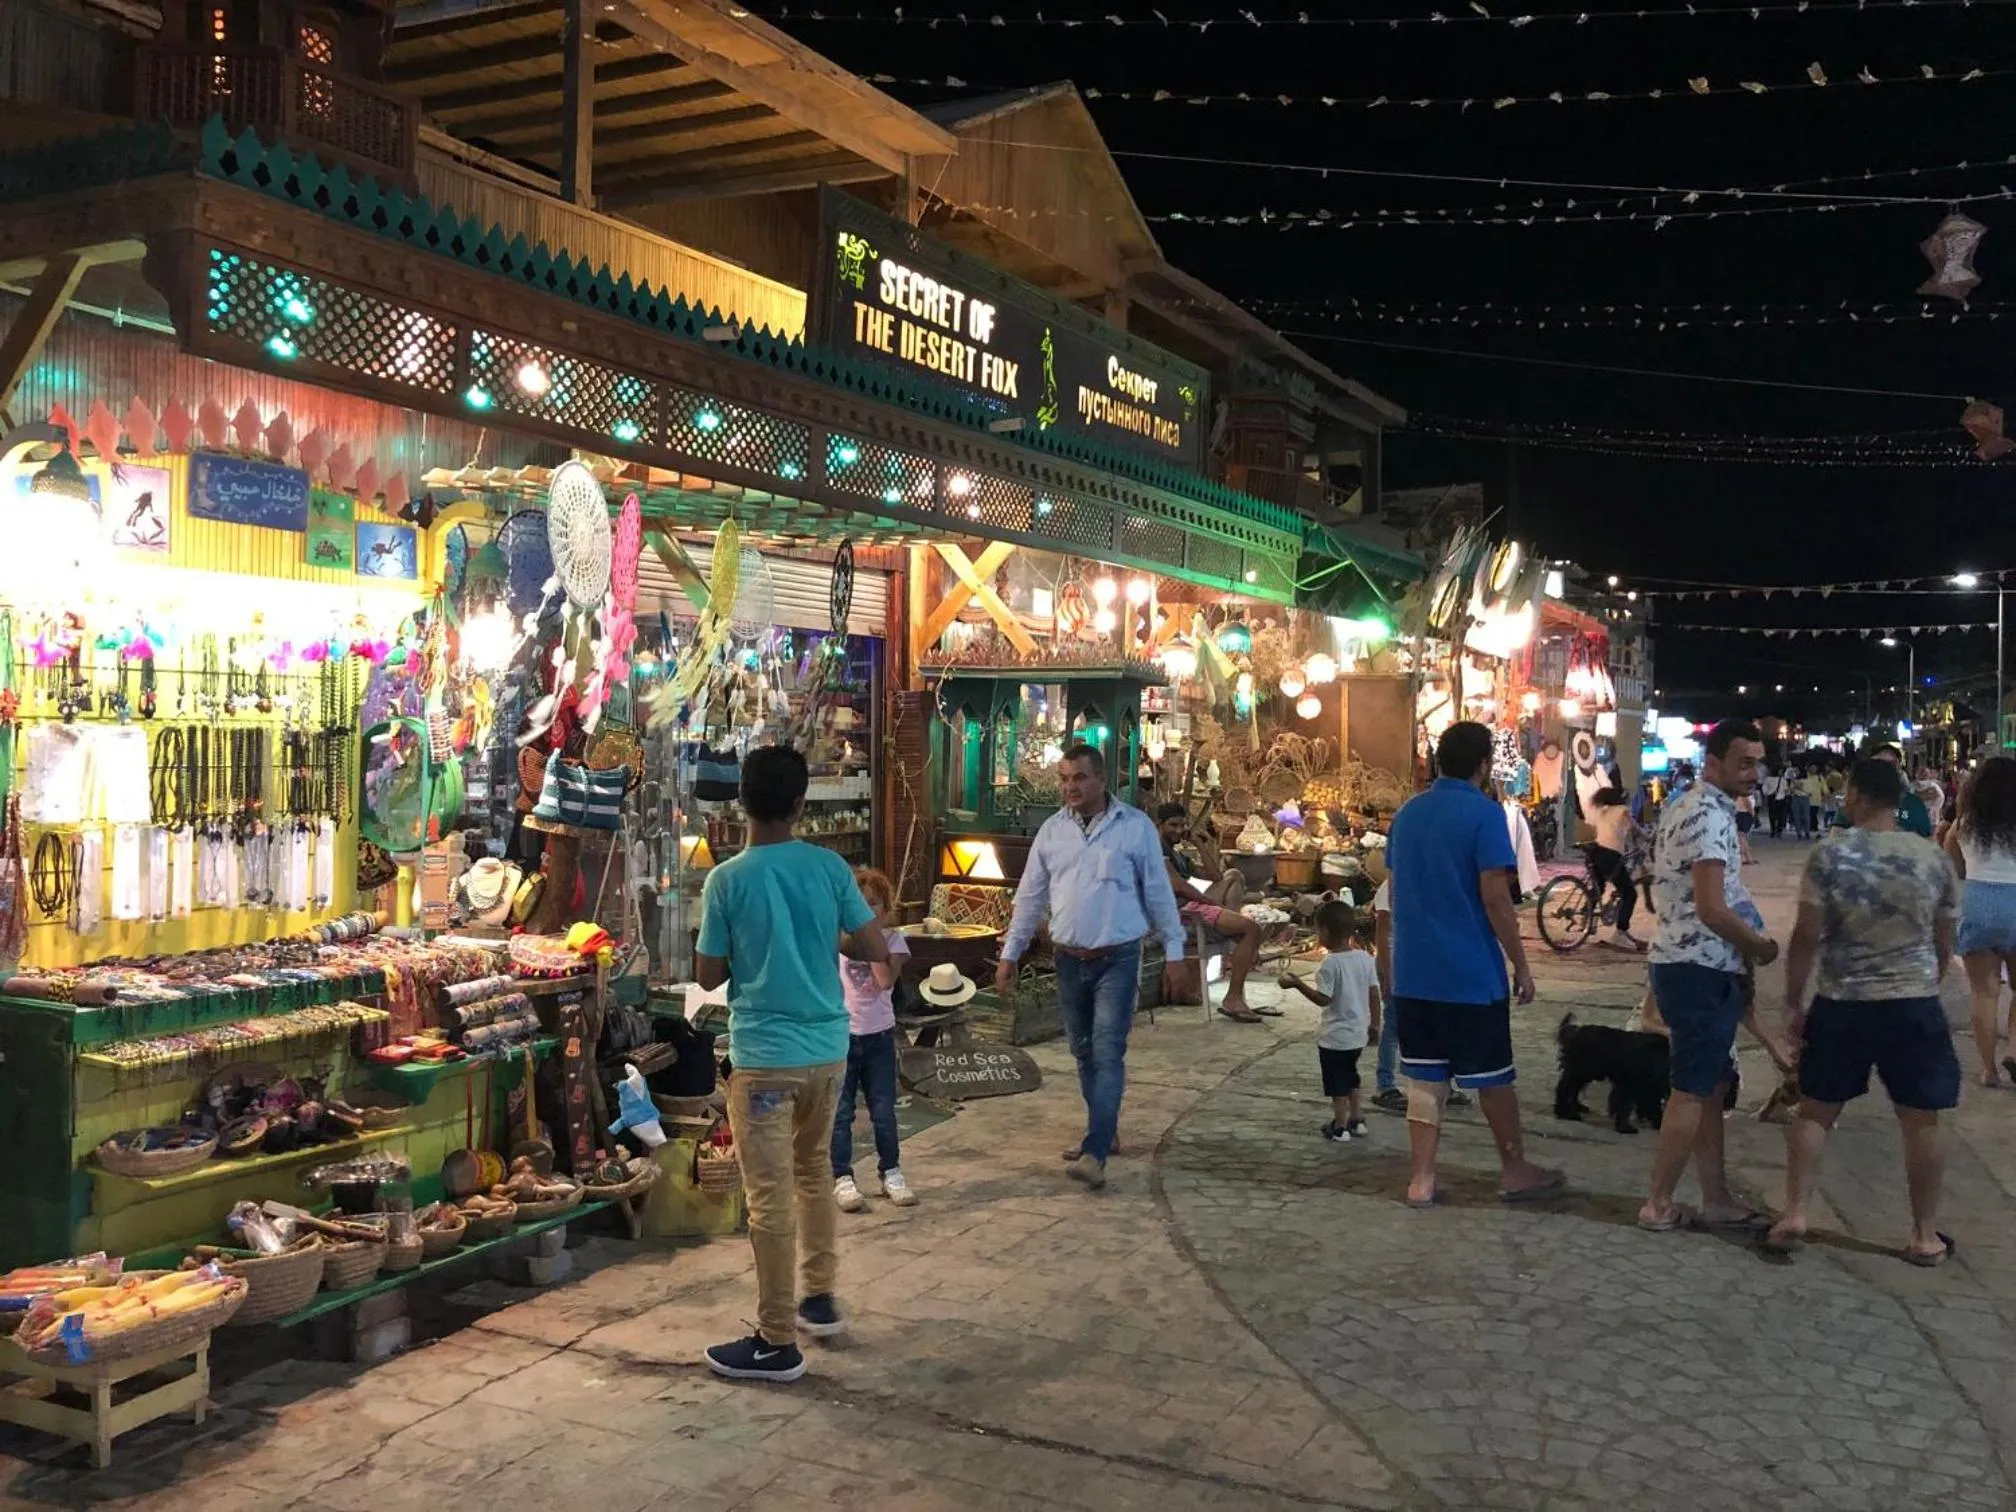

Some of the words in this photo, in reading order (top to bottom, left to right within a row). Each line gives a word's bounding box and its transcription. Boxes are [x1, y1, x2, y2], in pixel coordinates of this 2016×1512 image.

[880, 259, 965, 332] SECRET
[969, 299, 996, 344] OF
[854, 301, 895, 353] THE
[900, 320, 977, 383] DESERT
[981, 351, 1019, 399] FOX
[1107, 355, 1158, 404] Секрет
[1078, 385, 1151, 436] пустынного
[1153, 415, 1180, 448] лиса
[934, 1053, 968, 1066] Red
[973, 1052, 1012, 1065] Sea
[936, 1066, 1022, 1083] Cosmetics
